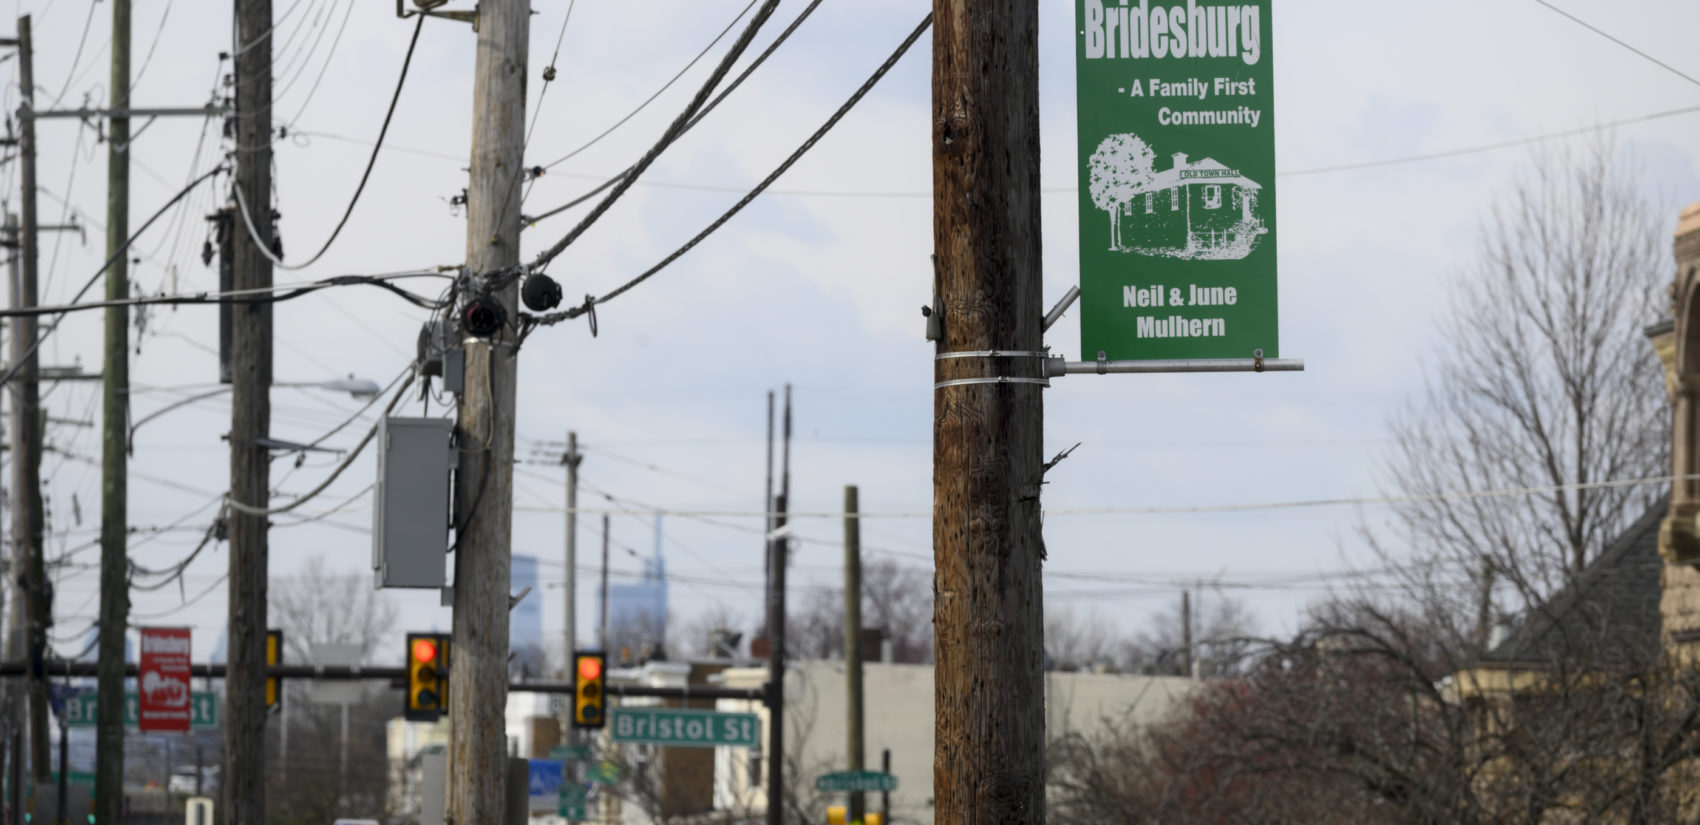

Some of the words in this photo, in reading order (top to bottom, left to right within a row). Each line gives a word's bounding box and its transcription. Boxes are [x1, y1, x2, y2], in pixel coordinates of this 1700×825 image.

[1084, 0, 1261, 65] Bridesburg
[1130, 79, 1144, 97] A
[1149, 78, 1208, 100] Family
[1214, 77, 1256, 96] First
[1158, 106, 1261, 128] Community
[1184, 170, 1198, 178] OLD
[1200, 169, 1220, 177] TOWN
[1221, 169, 1240, 177] HALL
[1123, 284, 1165, 308] Neil
[1169, 287, 1184, 307] &
[1188, 284, 1237, 306] June
[1136, 315, 1226, 339] Mulhern
[617, 713, 714, 740] Bristol
[724, 717, 752, 741] St
